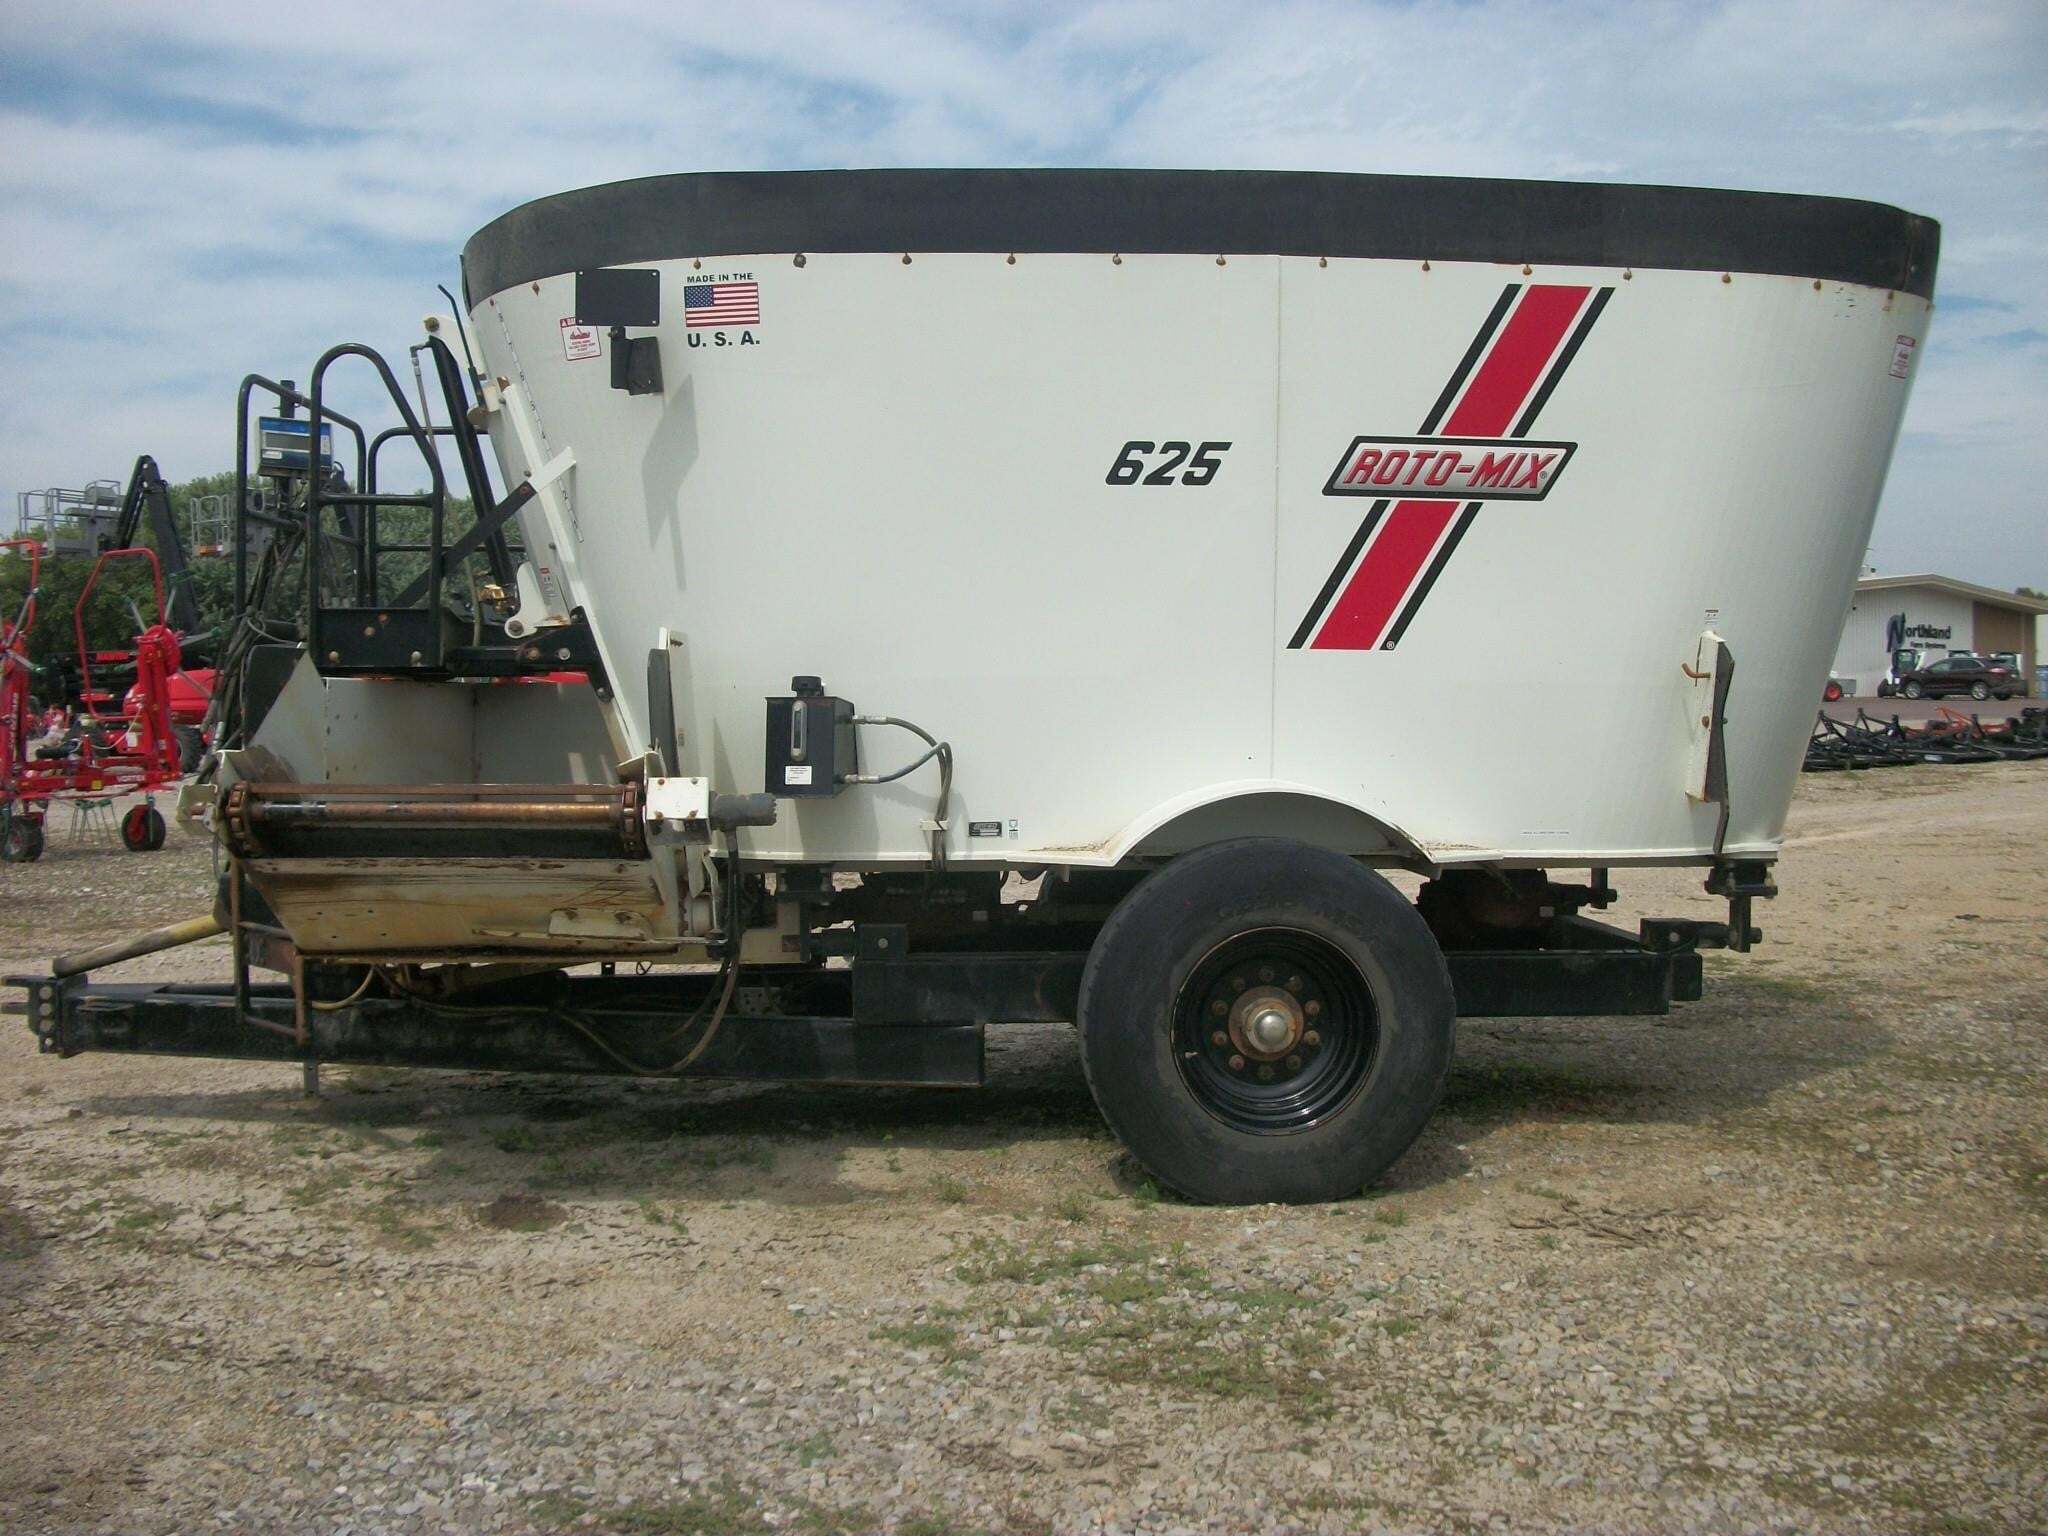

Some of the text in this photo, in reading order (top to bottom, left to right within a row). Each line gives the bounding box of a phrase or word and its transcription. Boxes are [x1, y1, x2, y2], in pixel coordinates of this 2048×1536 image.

[687, 272, 754, 283] MADE IN THE
[1105, 440, 1233, 486] 625
[1343, 448, 1559, 489] ROTO-MIX
[1887, 611, 1951, 653] Northland
